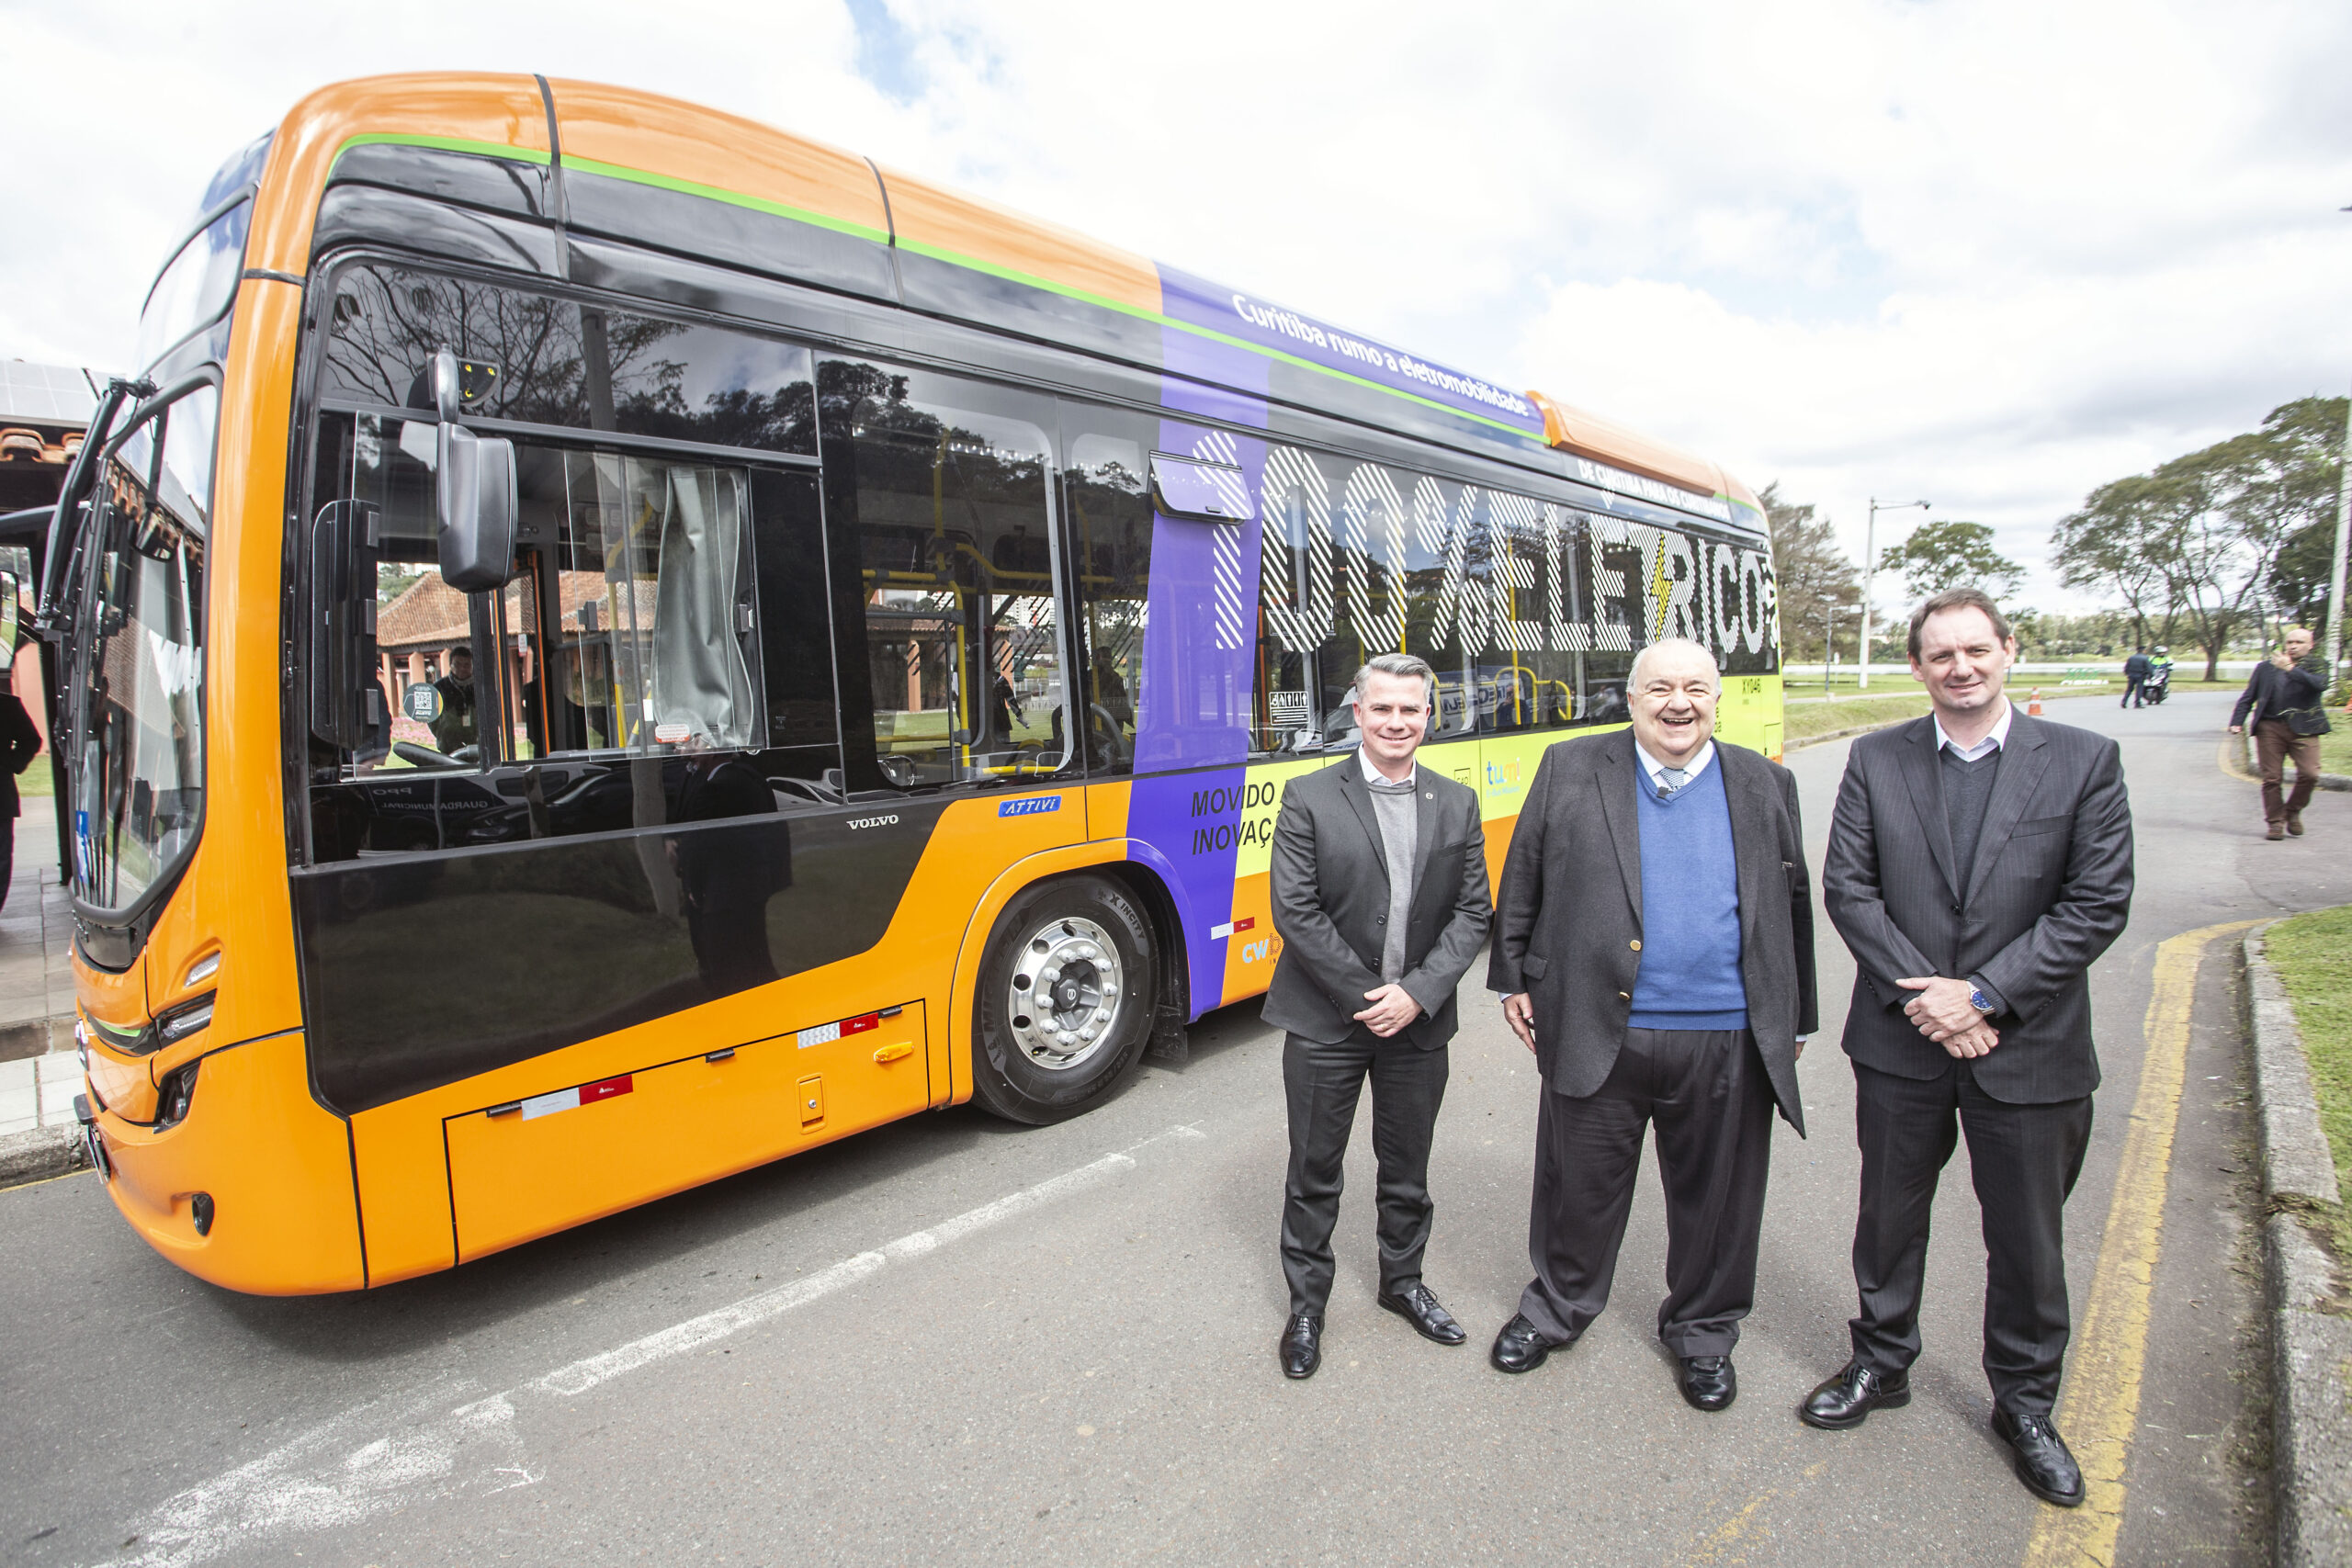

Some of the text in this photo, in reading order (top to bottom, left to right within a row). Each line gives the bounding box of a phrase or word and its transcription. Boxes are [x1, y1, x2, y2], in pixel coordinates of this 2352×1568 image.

[1232, 294, 1529, 417] Curitiba rumo a eletromobilidade
[1577, 459, 1596, 481] DE
[1486, 756, 1521, 785] tumi
[1191, 781, 1275, 818] MOVIDO
[846, 814, 899, 830] VOLVO
[1192, 817, 1275, 855] INOVAÇ
[1120, 902, 1146, 940] INCITY
